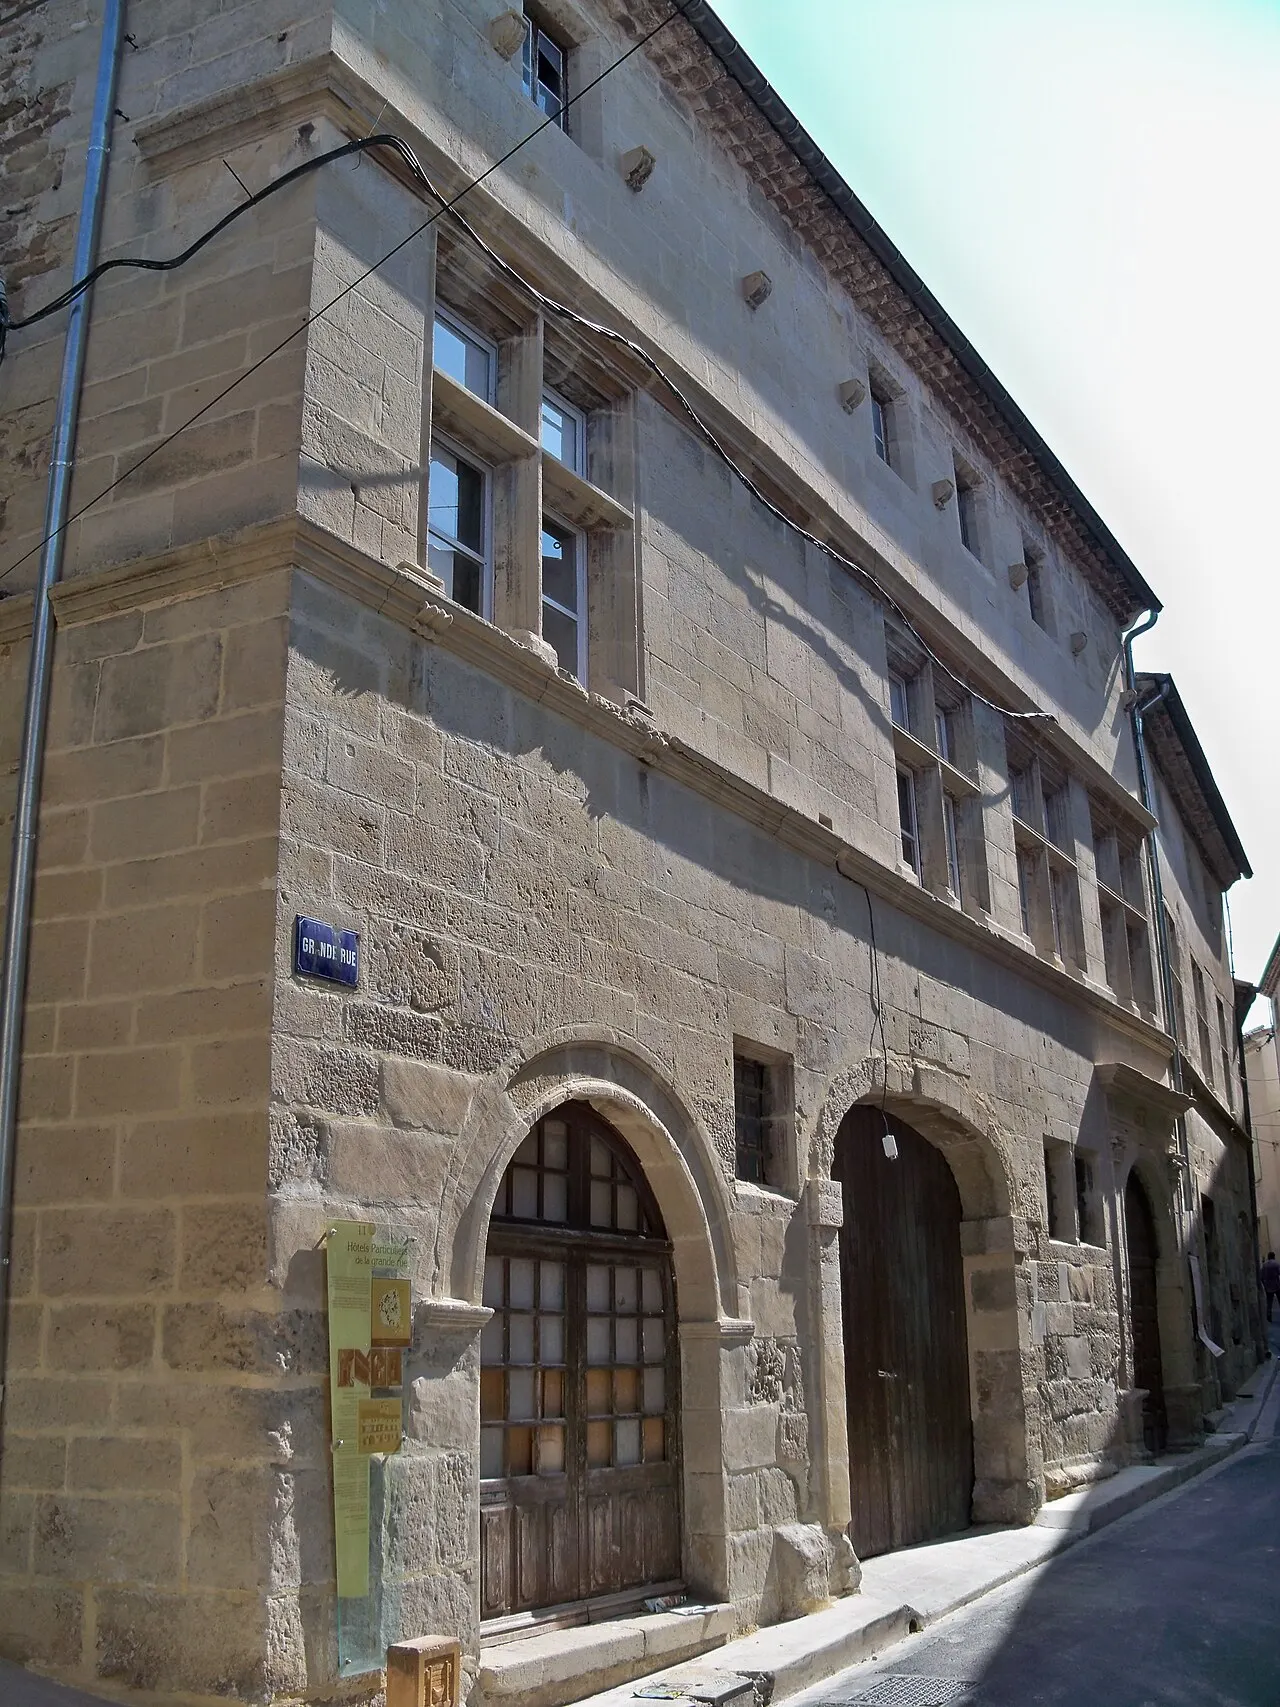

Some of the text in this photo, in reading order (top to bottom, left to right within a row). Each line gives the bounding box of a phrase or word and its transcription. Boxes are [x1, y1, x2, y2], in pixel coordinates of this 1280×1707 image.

[302, 937, 357, 967] GRNDE RUE
[347, 1241, 370, 1253] Hôtels
[355, 1256, 363, 1265] de
[364, 1256, 370, 1265] la
[371, 1256, 395, 1267] grande
